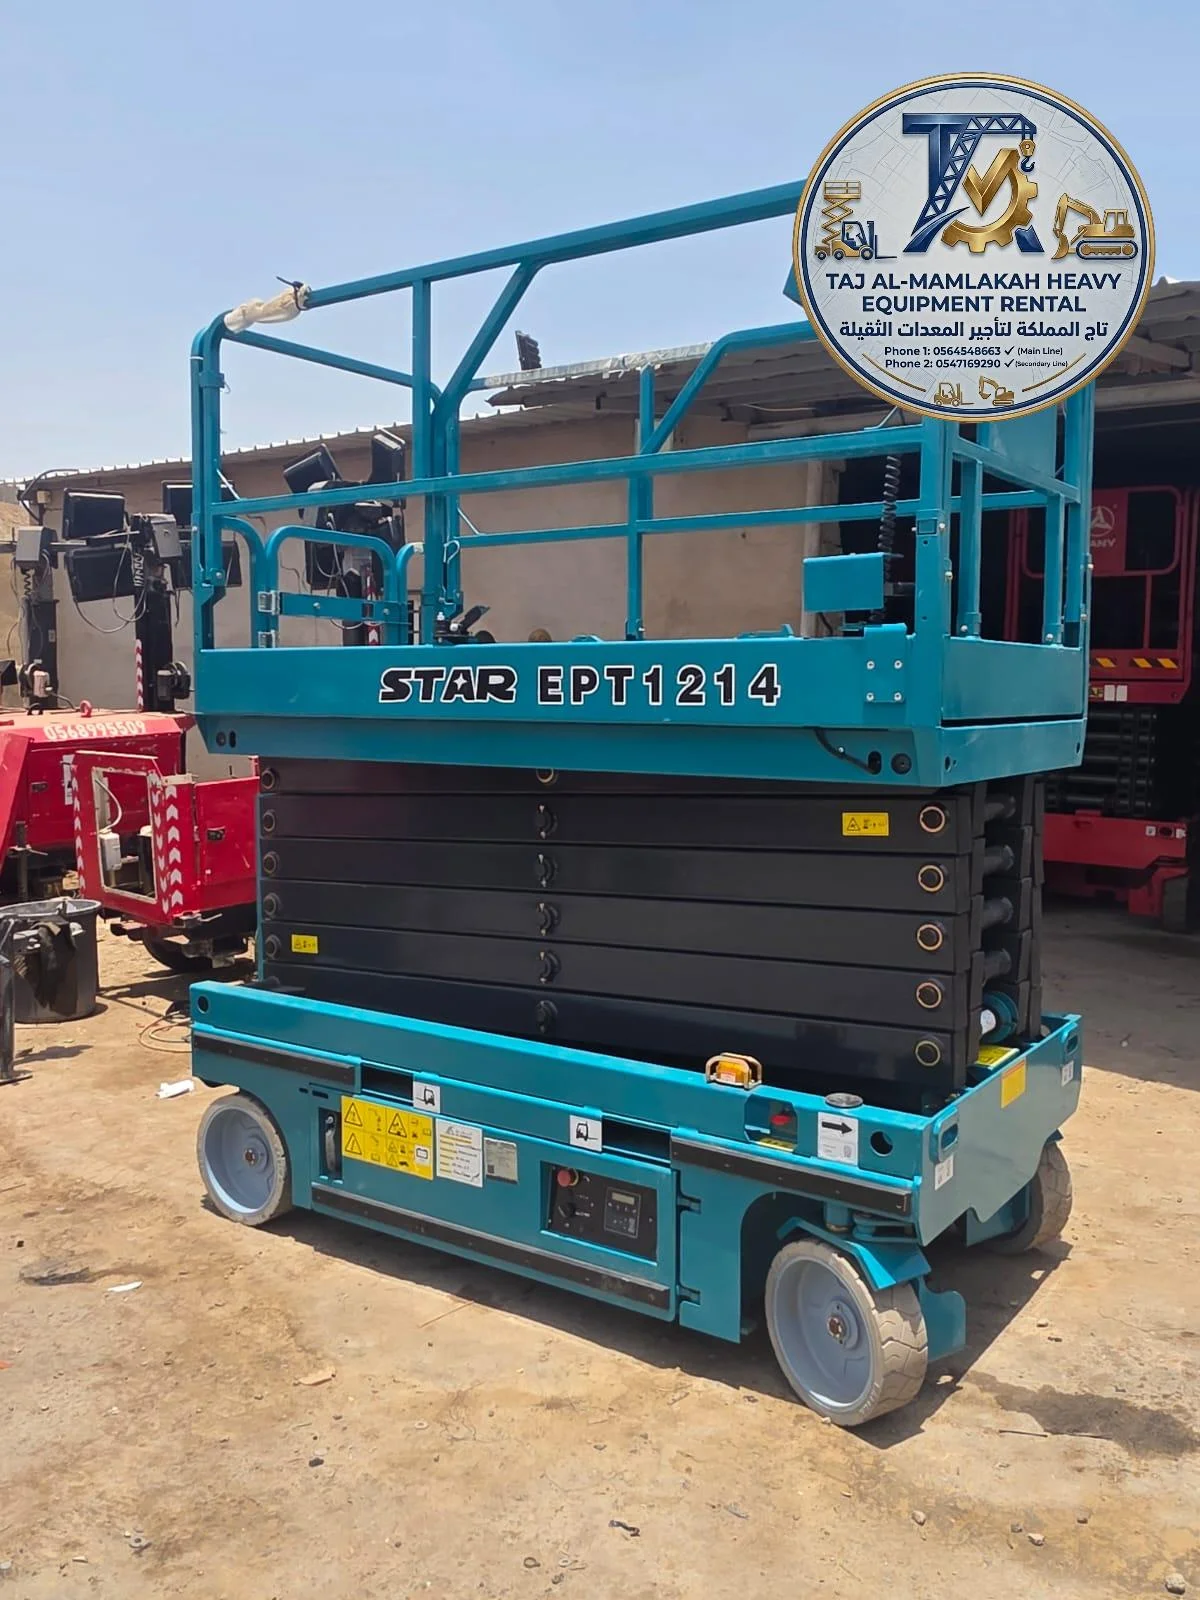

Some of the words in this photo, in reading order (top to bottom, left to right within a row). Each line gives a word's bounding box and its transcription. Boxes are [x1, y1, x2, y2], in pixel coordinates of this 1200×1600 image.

[1090, 538, 1116, 548] ANY
[379, 665, 518, 703] STAR
[538, 664, 782, 706] EPT1214
